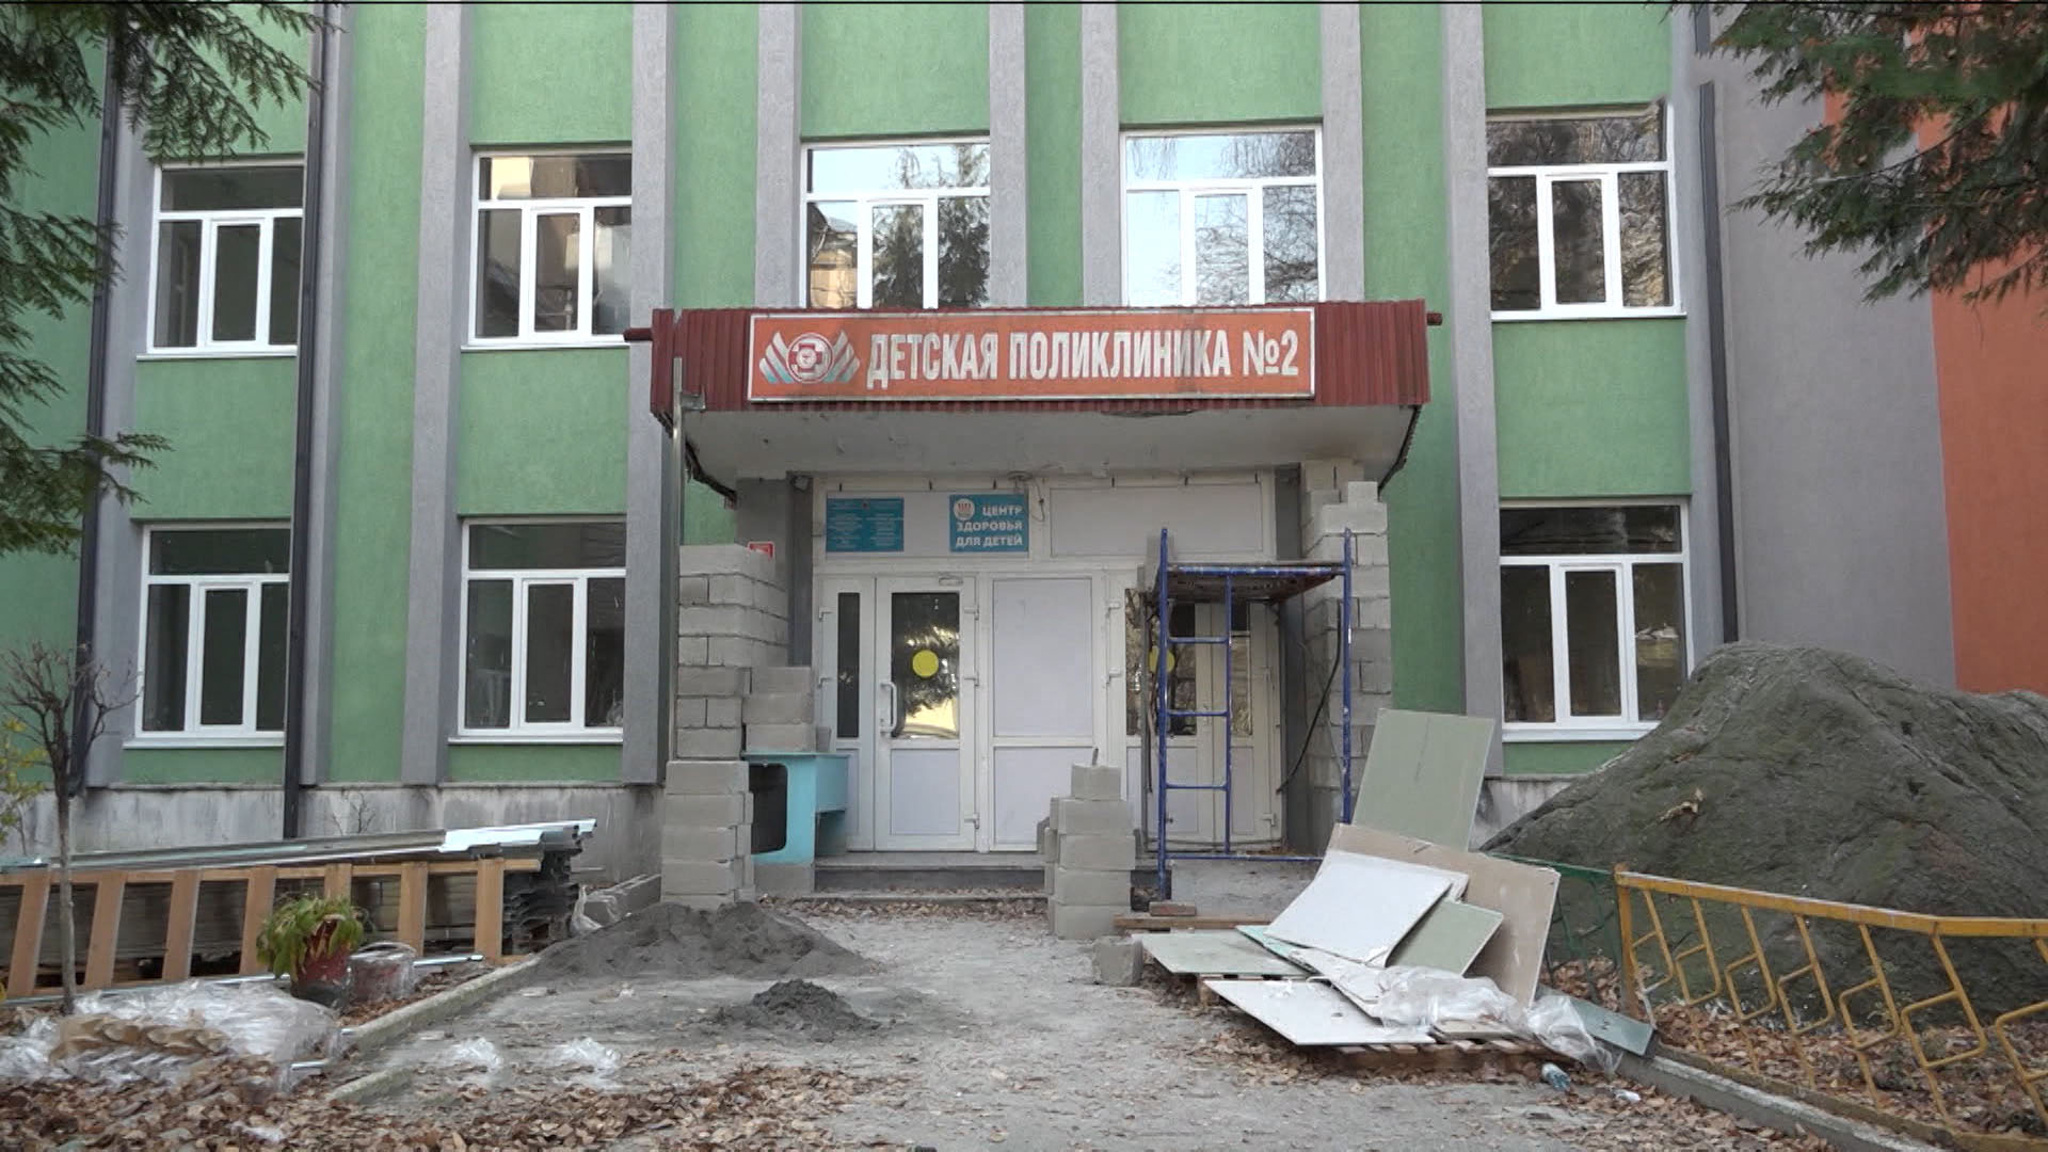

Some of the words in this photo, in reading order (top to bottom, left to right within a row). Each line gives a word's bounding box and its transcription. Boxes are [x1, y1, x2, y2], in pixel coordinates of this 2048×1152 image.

[867, 331, 998, 389] ДЕТСКАЯ
[1009, 329, 1231, 380] ПОЛИКЛИНИКА
[1242, 328, 1300, 378] №2
[982, 504, 1024, 517] ЦЕНТР
[956, 520, 1023, 533] ЗДОРОВЬЯ
[955, 536, 981, 549] ДЛЯ
[983, 534, 1023, 548] ДЕТЕЙ
